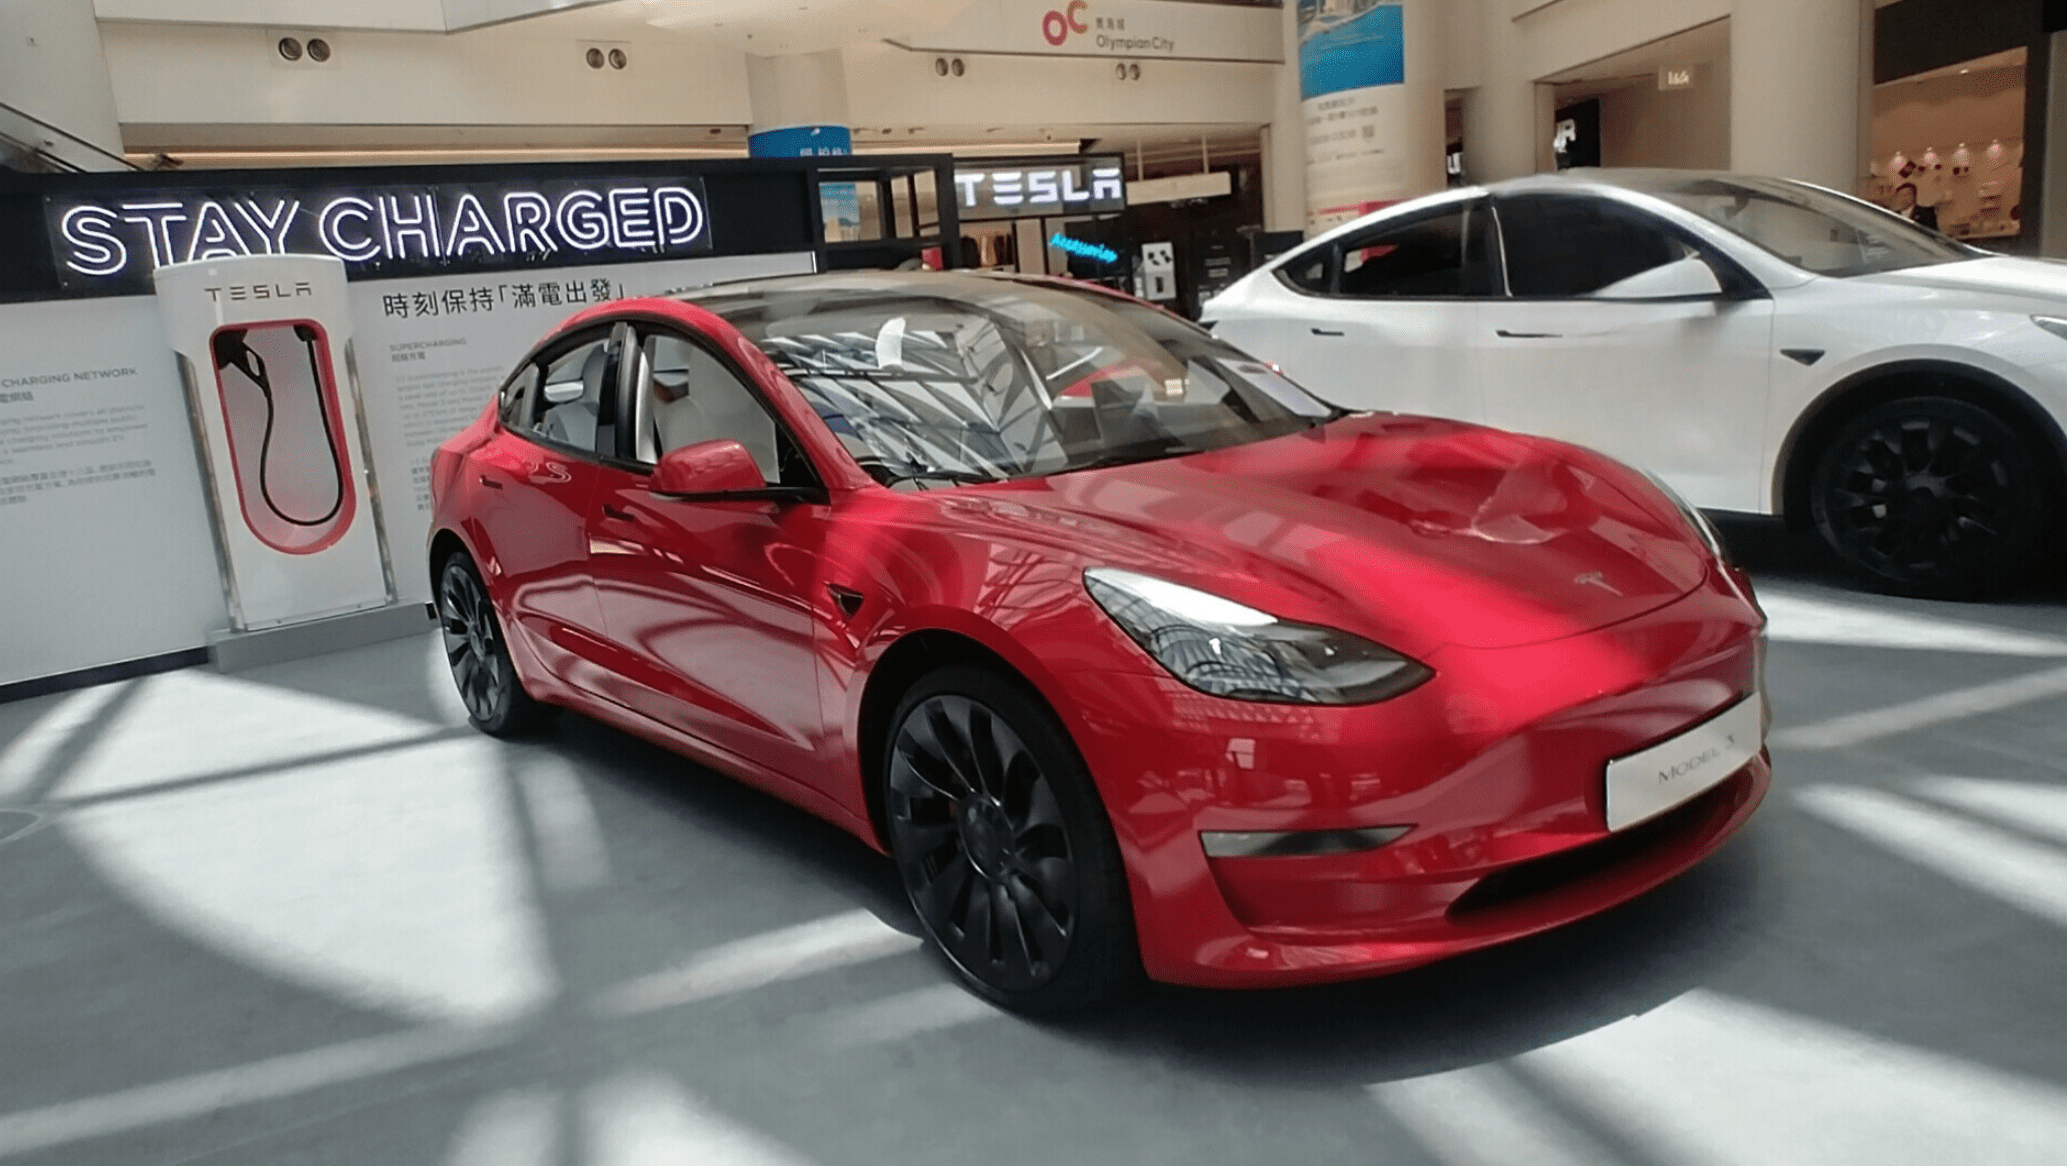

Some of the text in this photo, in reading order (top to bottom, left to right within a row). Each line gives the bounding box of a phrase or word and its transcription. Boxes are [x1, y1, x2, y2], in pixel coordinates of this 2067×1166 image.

[1096, 34, 1175, 53] Olympian City
[953, 167, 1122, 207] TESLA
[61, 186, 704, 276] STAY CHARGED
[204, 282, 312, 302] TESLA
[390, 338, 467, 352] SUPERCHARGING
[1, 367, 138, 388] CHARGING NETWORK
[1657, 746, 1721, 784] MODEL
